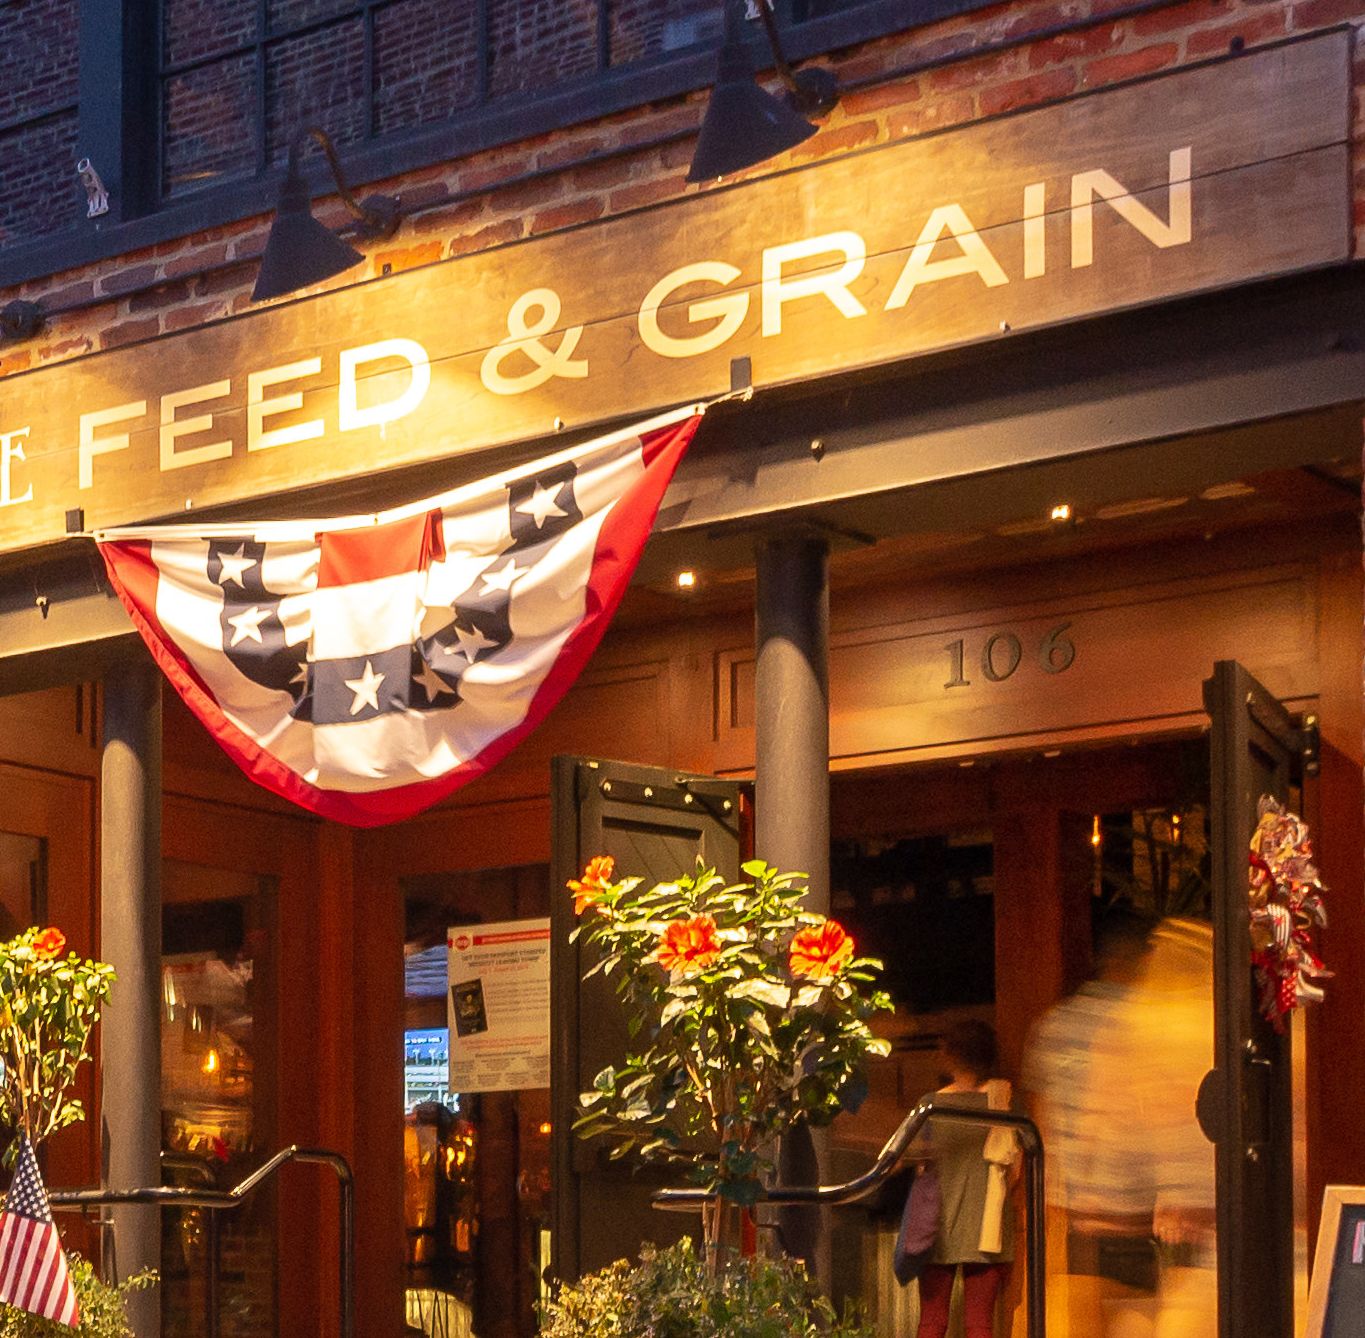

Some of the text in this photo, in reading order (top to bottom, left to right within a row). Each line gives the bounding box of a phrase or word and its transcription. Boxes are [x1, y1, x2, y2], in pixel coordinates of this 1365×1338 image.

[78, 338, 432, 491] FEED
[480, 287, 589, 396] &
[637, 146, 1192, 358] GRAIN
[943, 622, 1076, 691] 106
